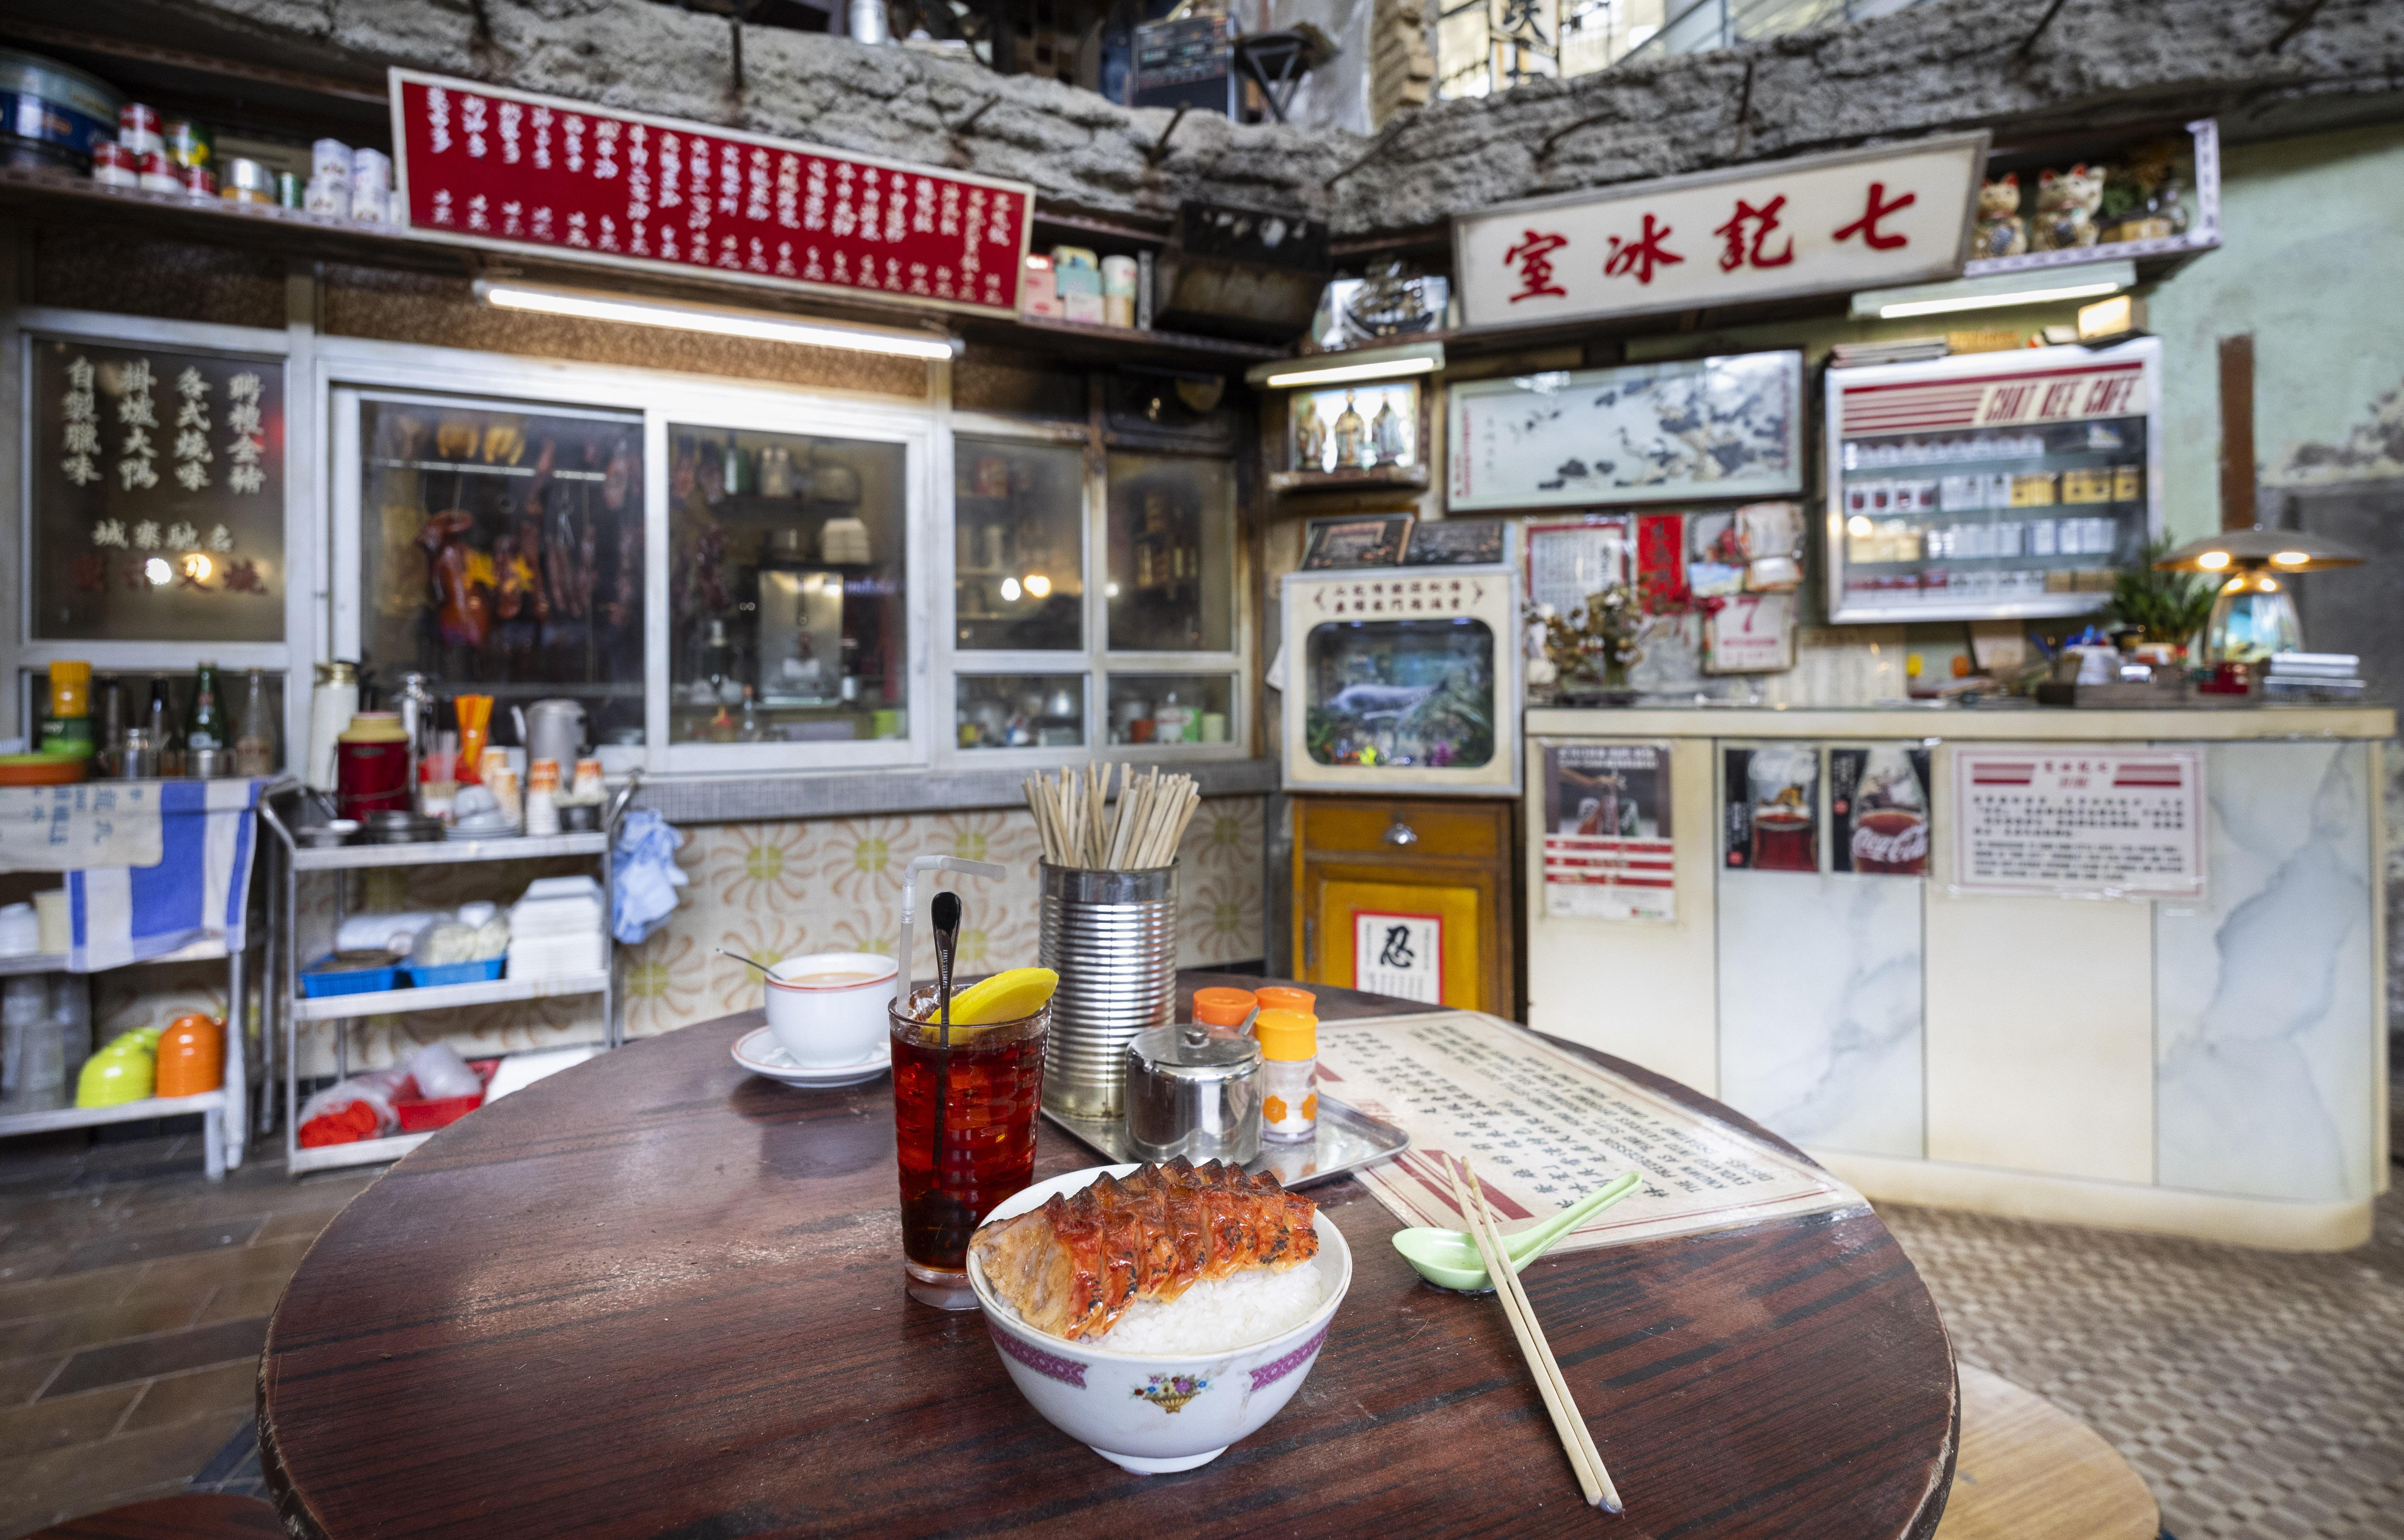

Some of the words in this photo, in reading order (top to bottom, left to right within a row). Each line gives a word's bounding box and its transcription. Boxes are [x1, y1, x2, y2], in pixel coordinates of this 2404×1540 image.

[1737, 598, 1762, 632] 7
[1380, 925, 1414, 968] 忍
[1595, 1137, 1681, 1178] PREDECESSOR
[1653, 1153, 1683, 1163] AS
[1660, 1142, 1700, 1157] INTO
[1675, 1165, 1732, 1189] KNOWN
[1690, 1157, 1756, 1185] EVOLVED
[1672, 1179, 1708, 1193] THE
